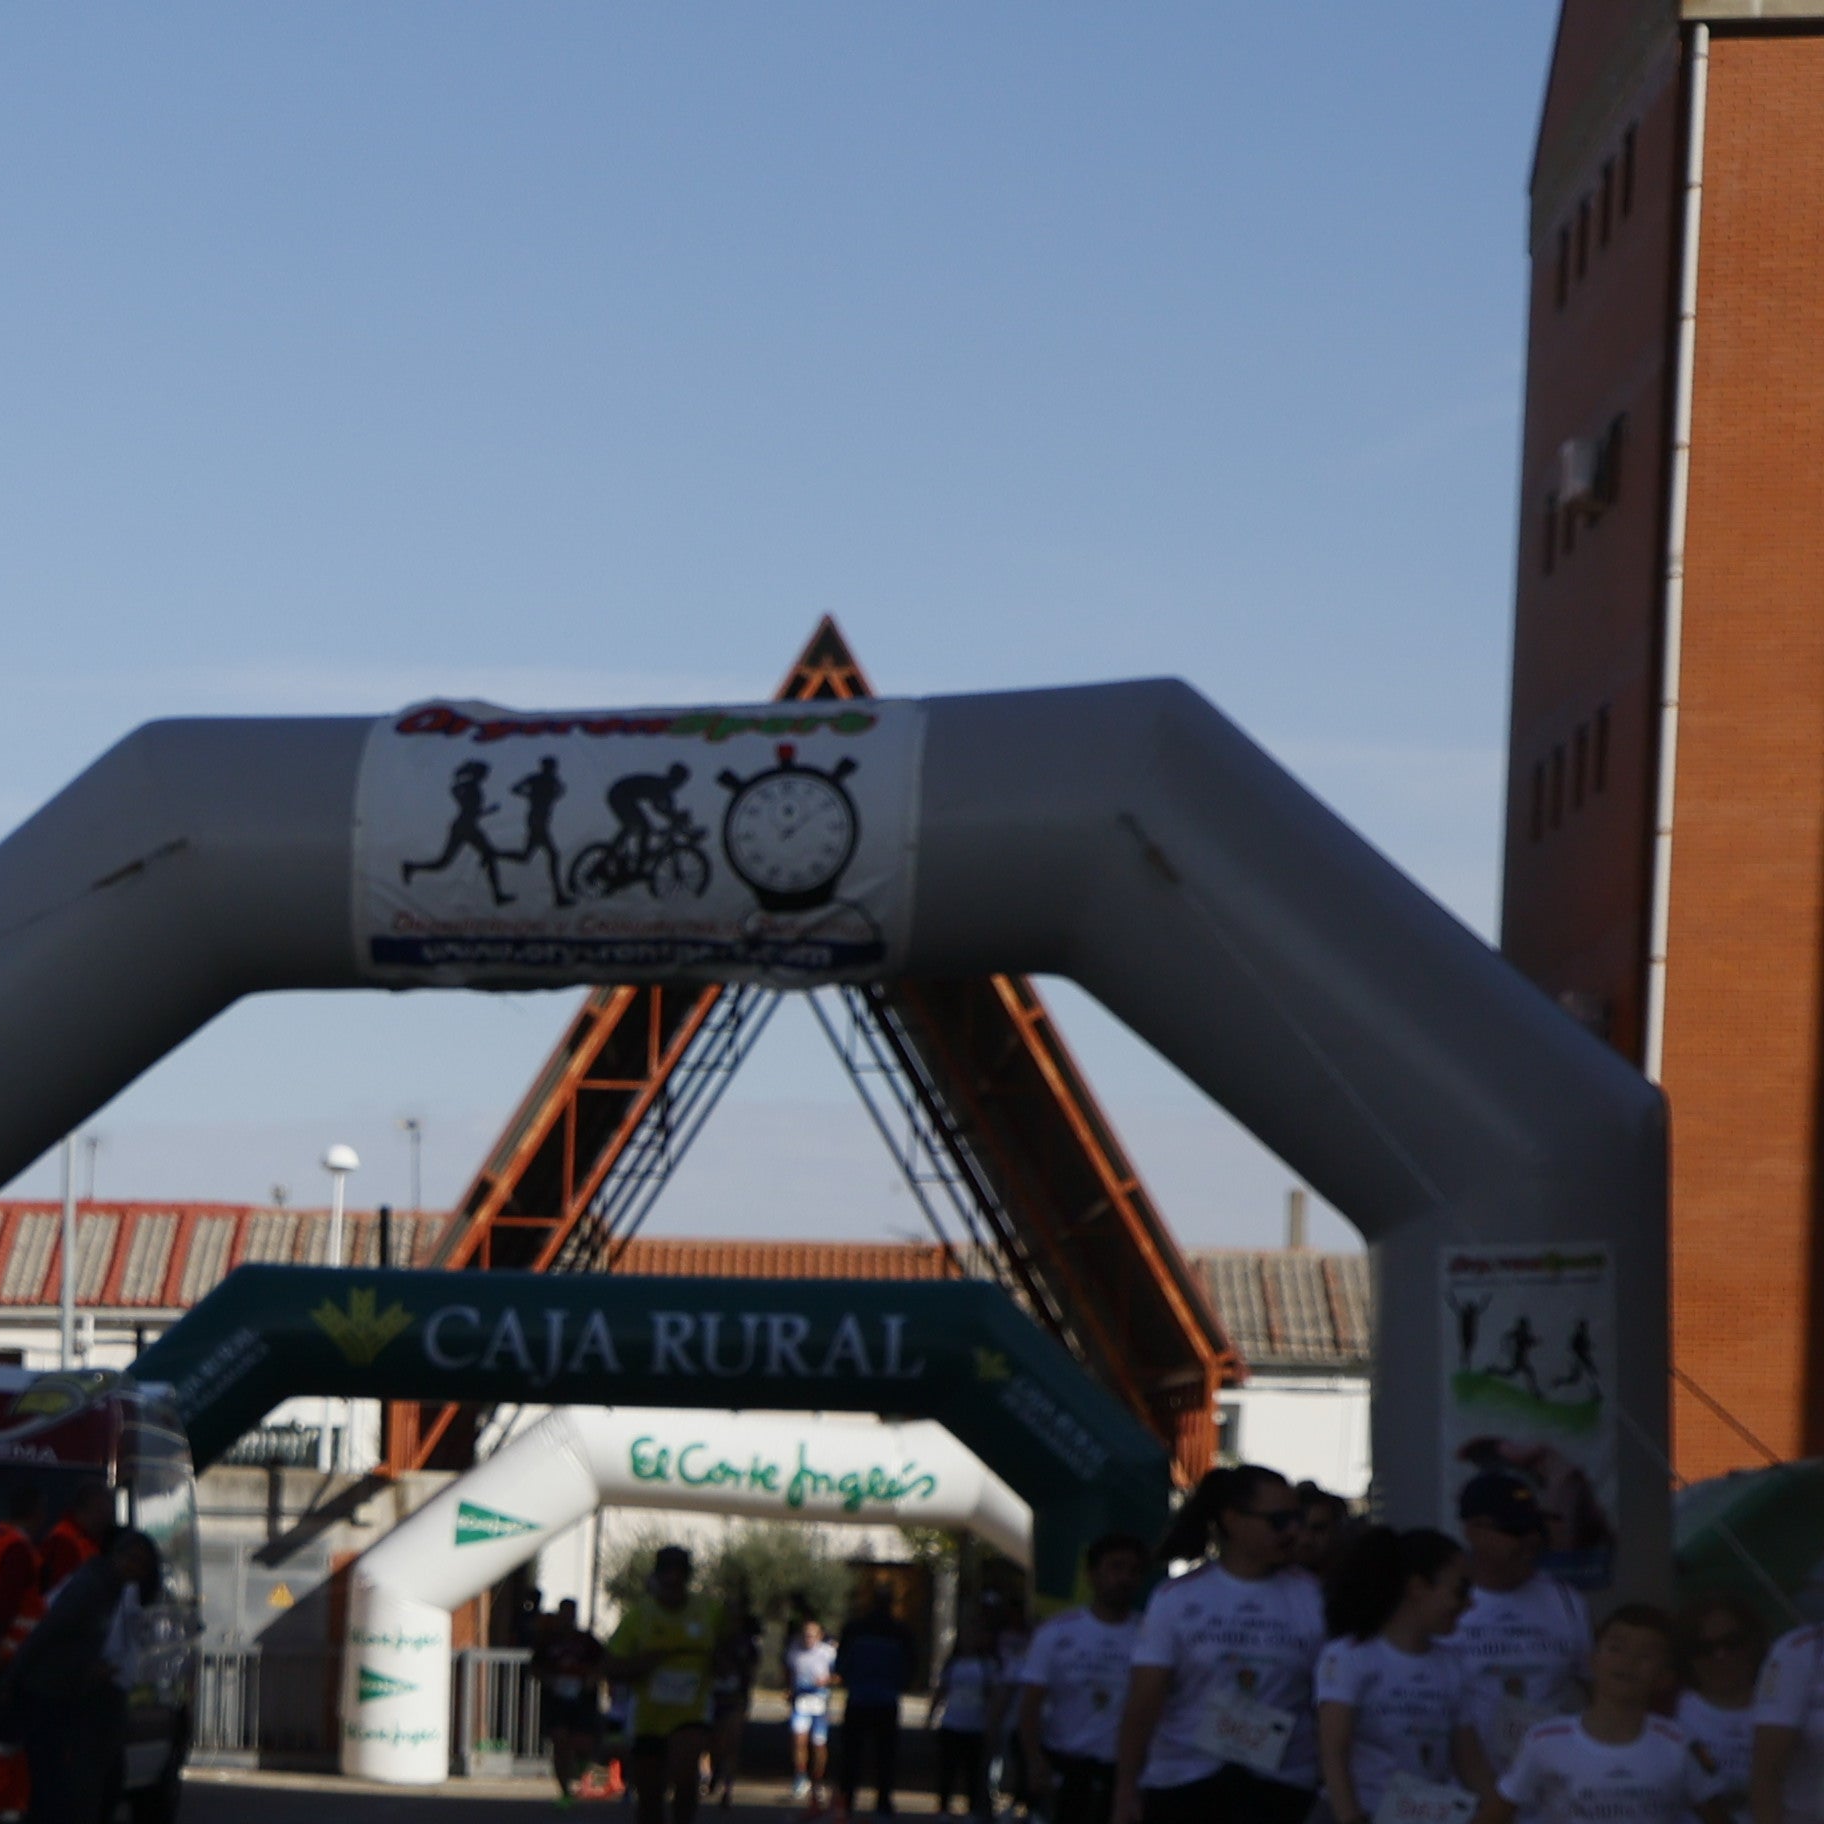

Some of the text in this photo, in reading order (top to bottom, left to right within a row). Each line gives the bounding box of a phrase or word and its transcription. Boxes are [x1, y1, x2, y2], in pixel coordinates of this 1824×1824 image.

[423, 1305, 925, 1384] CAJA RURAL
[631, 1438, 938, 1514] El Corte Inglés
